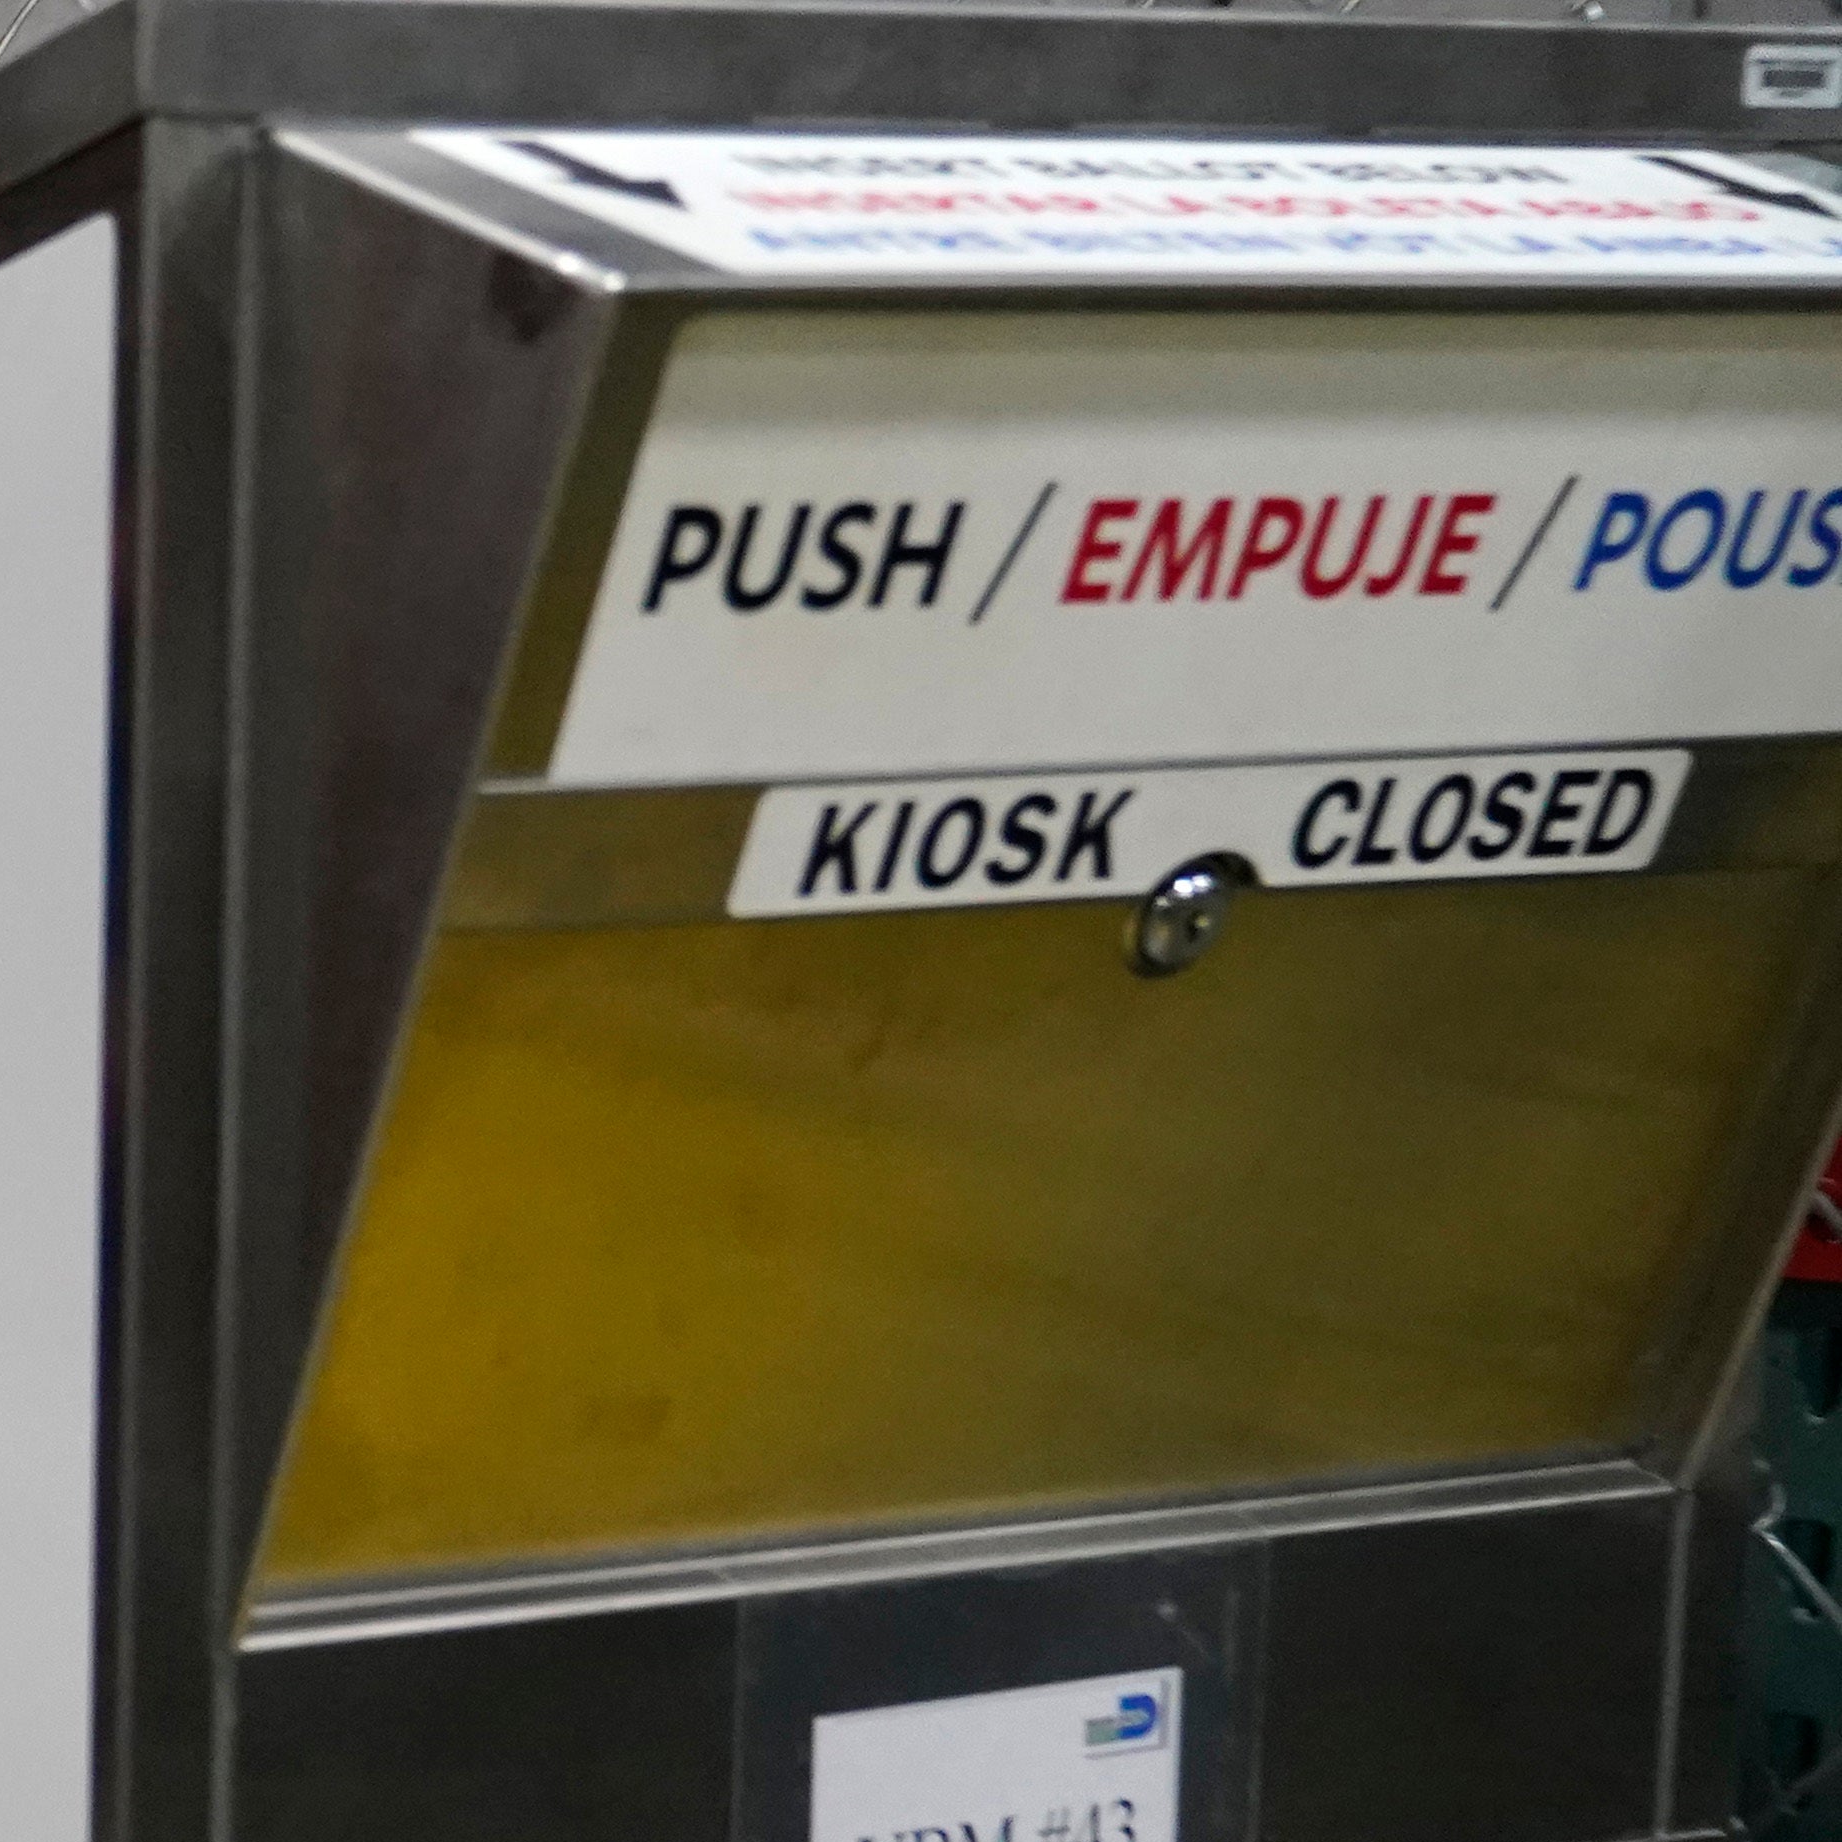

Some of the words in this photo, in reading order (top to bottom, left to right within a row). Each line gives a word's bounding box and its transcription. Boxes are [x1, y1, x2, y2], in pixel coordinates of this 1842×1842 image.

[643, 501, 966, 613] PUSH
[1060, 492, 1498, 605] EMPUJE
[797, 787, 1134, 900] KIOSK
[1291, 768, 1654, 874] CLOSED
